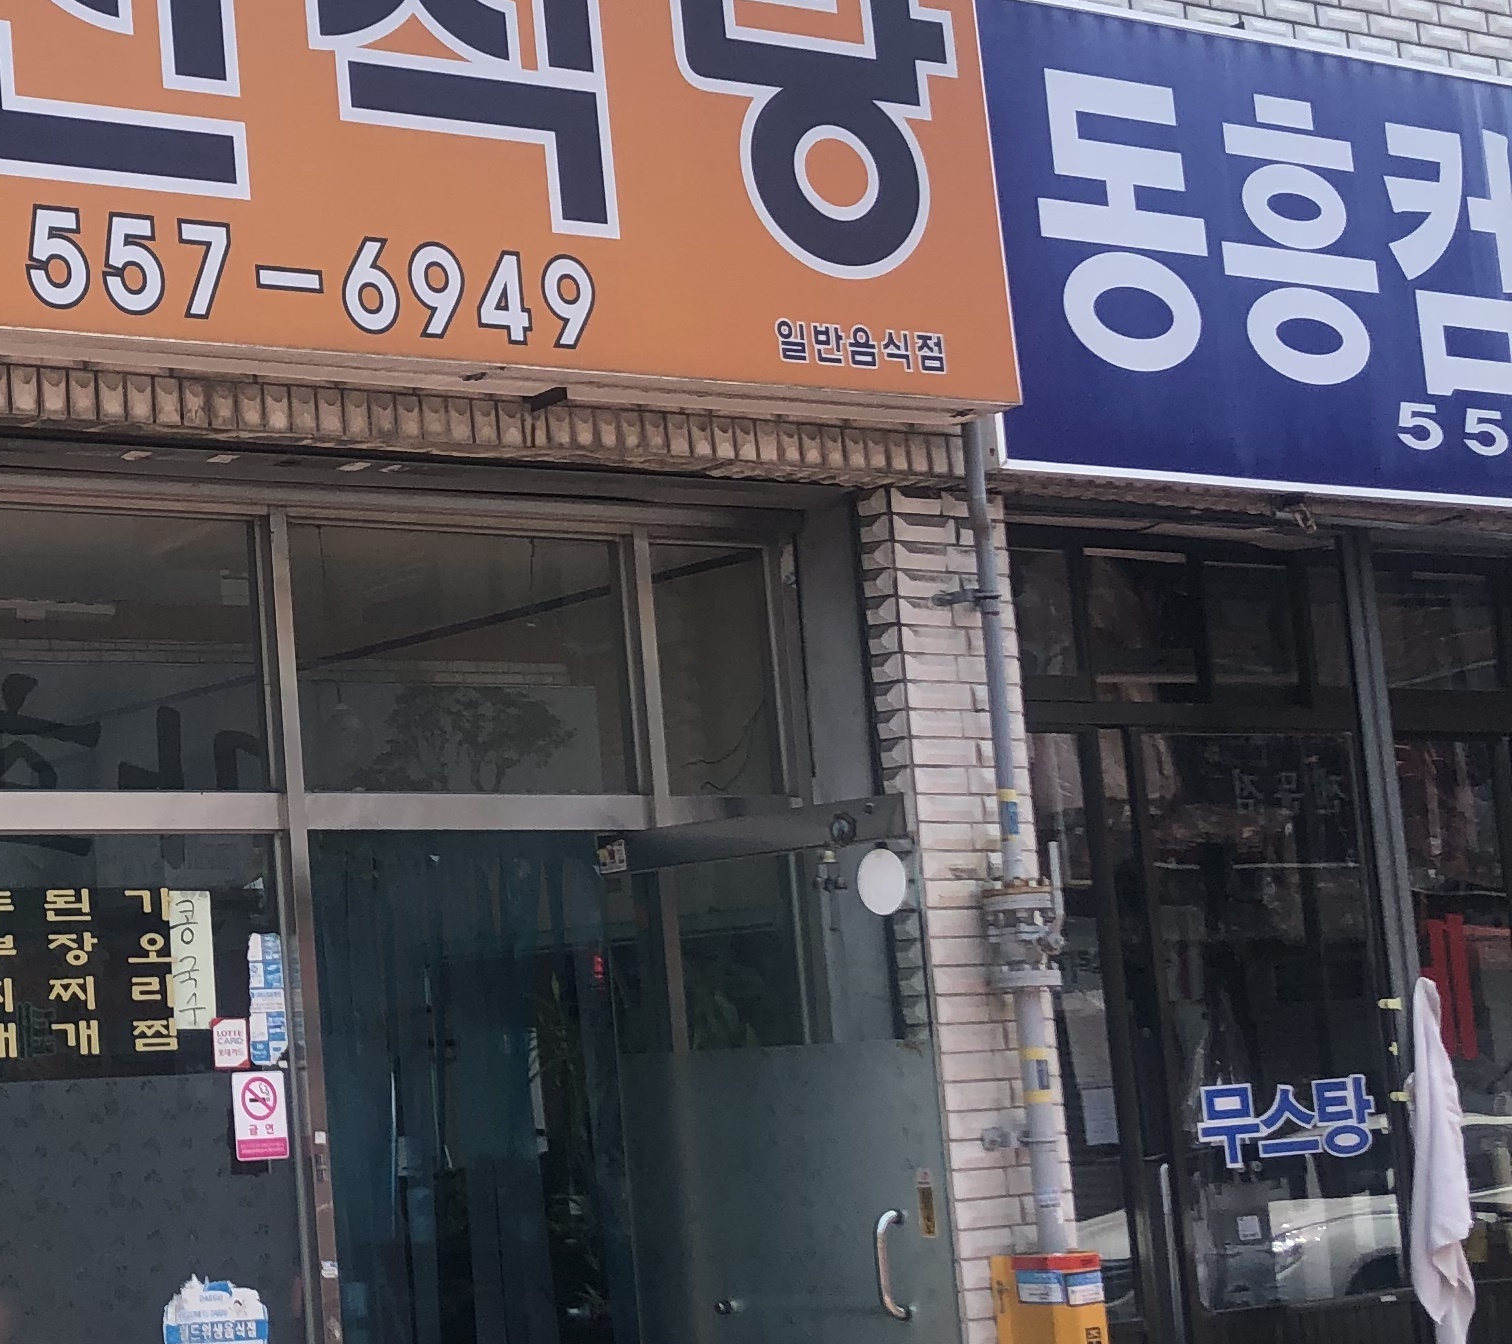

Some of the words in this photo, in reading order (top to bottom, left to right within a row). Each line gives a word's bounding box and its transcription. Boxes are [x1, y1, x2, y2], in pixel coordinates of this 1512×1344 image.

[25, 203, 596, 350] 557-6949
[774, 317, 947, 375] 일반음식점
[44, 888, 100, 1055] 된장찌개
[124, 887, 179, 1052] 가오리찜
[170, 899, 207, 1026] 콩국수
[248, 1123, 275, 1136] 금연
[1197, 1073, 1375, 1169] 무스탕
